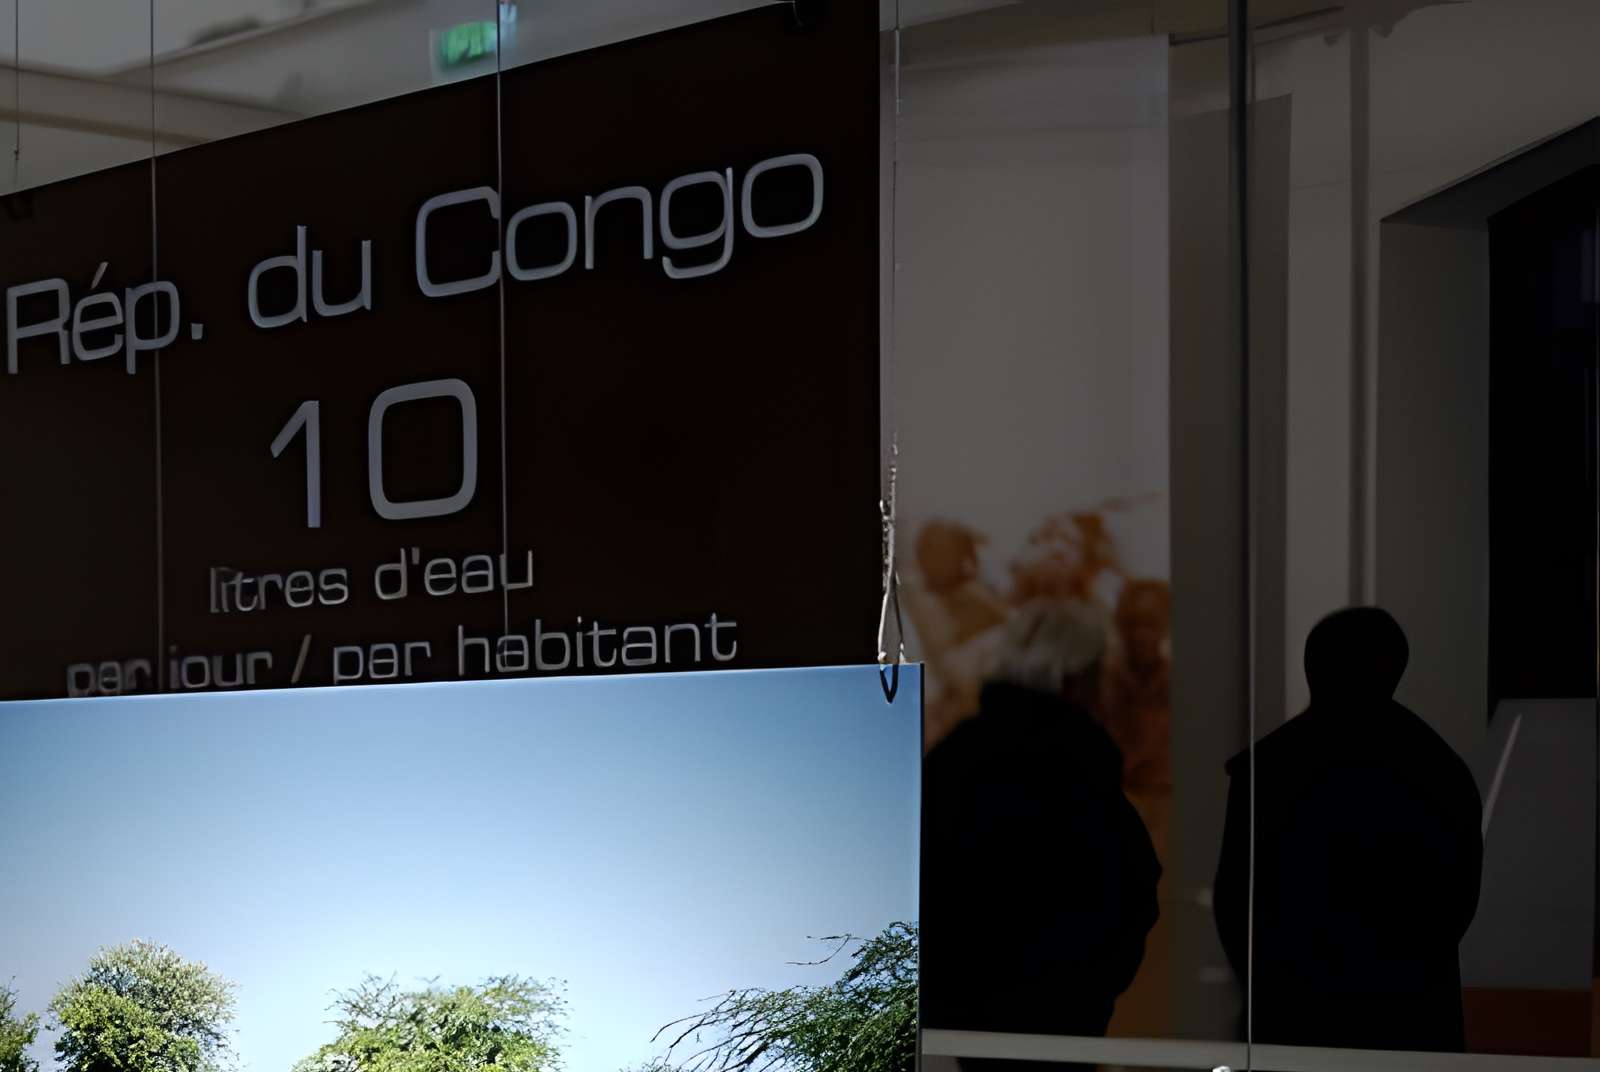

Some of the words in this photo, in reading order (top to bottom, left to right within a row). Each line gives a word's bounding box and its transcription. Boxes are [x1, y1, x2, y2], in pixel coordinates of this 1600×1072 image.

[7, 262, 203, 375] Rép.
[248, 225, 373, 329] du
[416, 153, 824, 297] Congo
[271, 377, 477, 528] 10
[210, 566, 349, 615] litres
[374, 547, 534, 600] d'eau
[67, 655, 151, 697] par
[169, 645, 273, 692] jour
[291, 634, 312, 685] /
[333, 640, 432, 685] par
[458, 612, 738, 676] habitant
